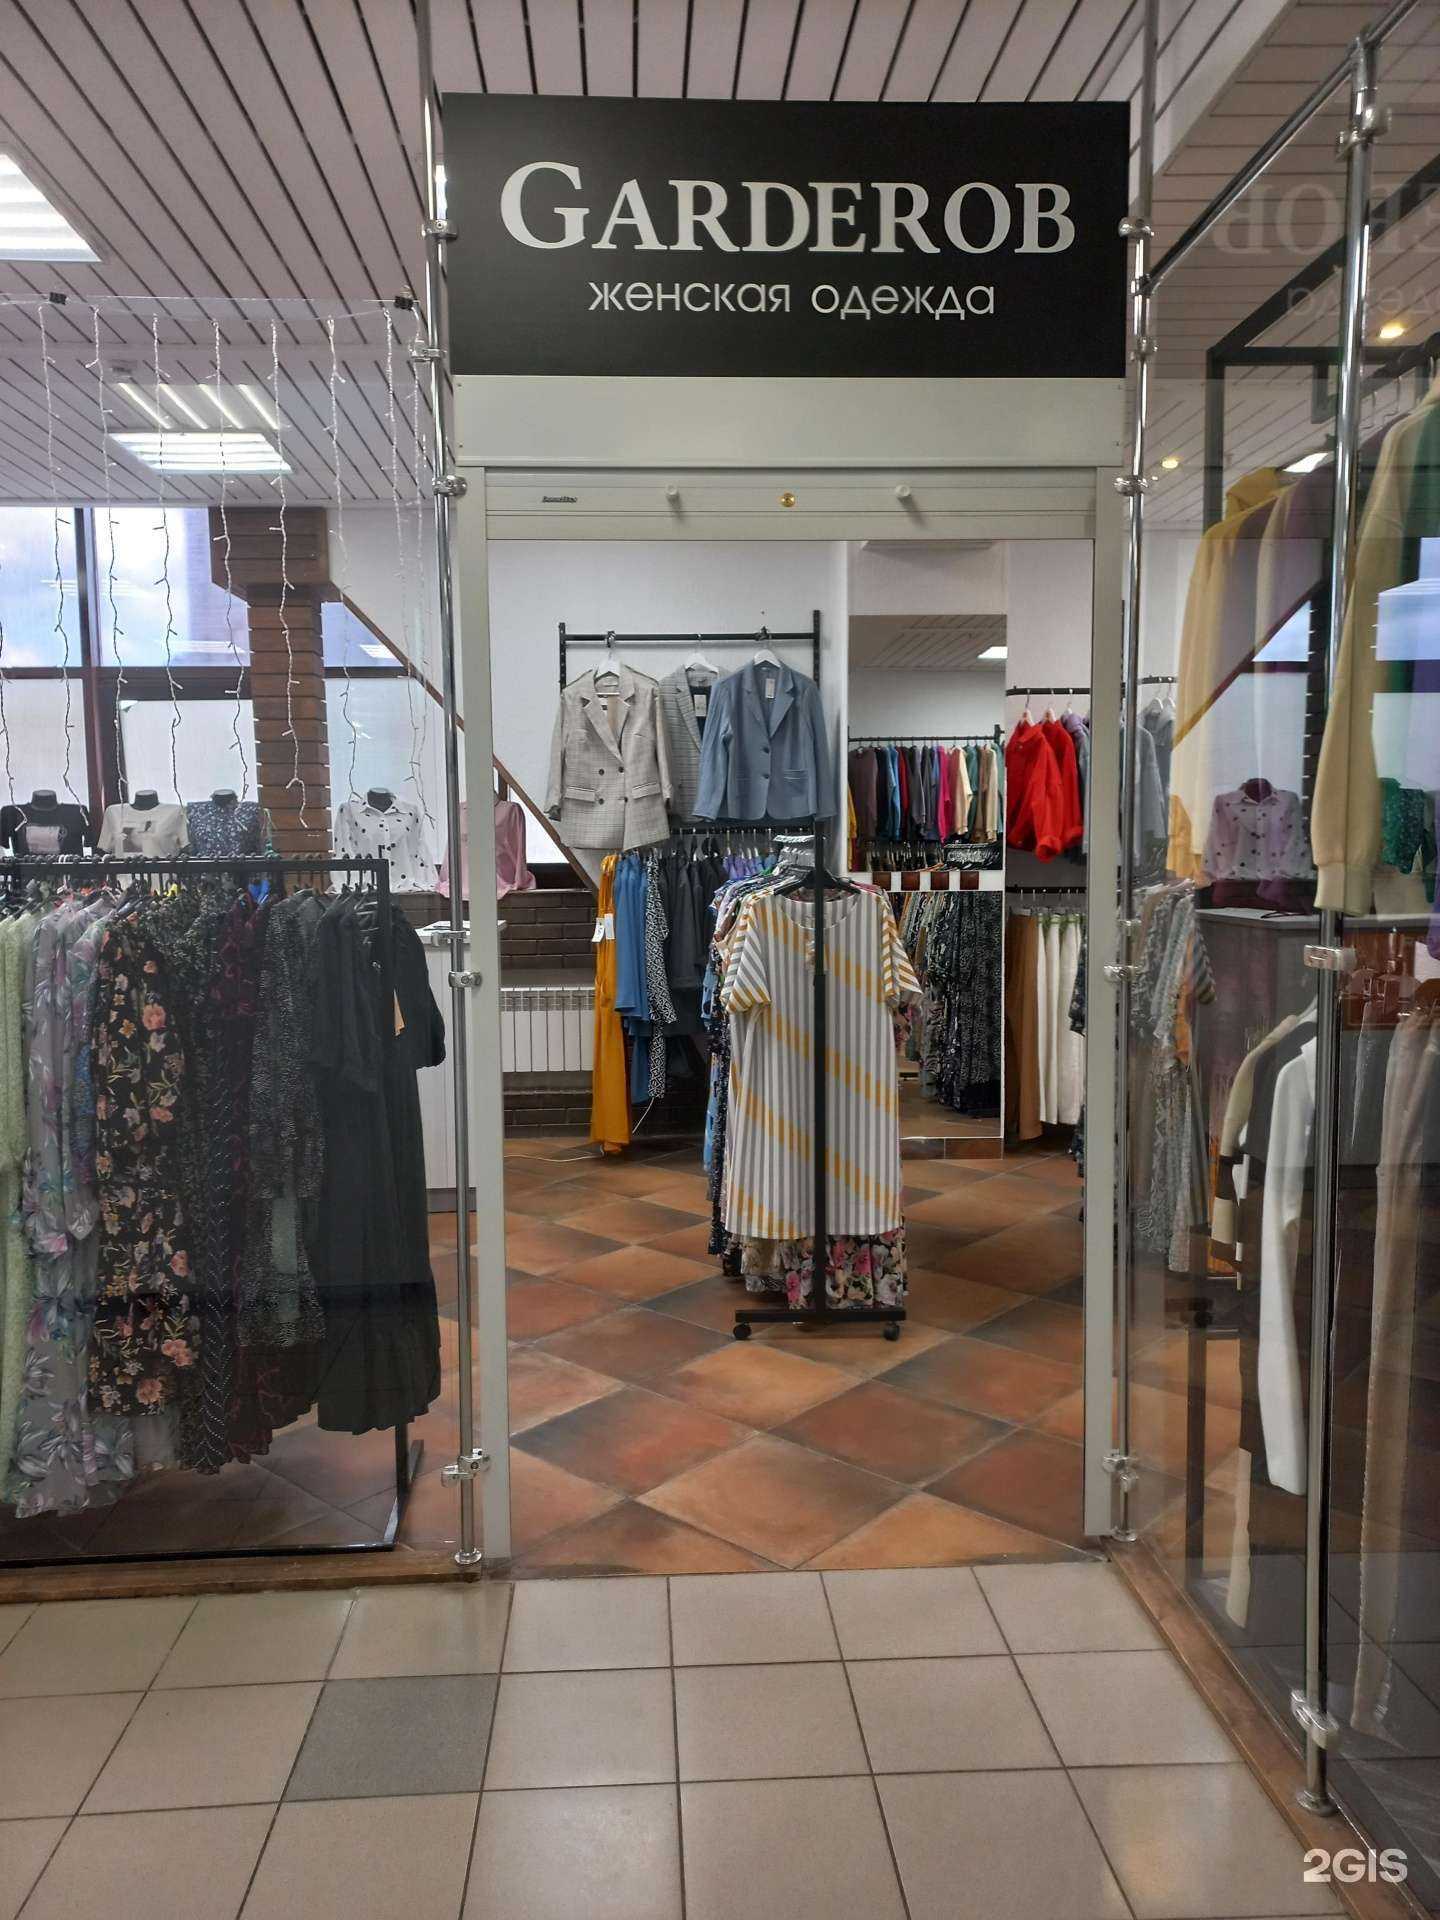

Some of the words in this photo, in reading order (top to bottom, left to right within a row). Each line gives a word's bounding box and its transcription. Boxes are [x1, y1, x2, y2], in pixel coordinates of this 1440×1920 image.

[499, 161, 1075, 254] GARDEROB
[588, 281, 791, 313] женская
[811, 284, 995, 321] одежда
